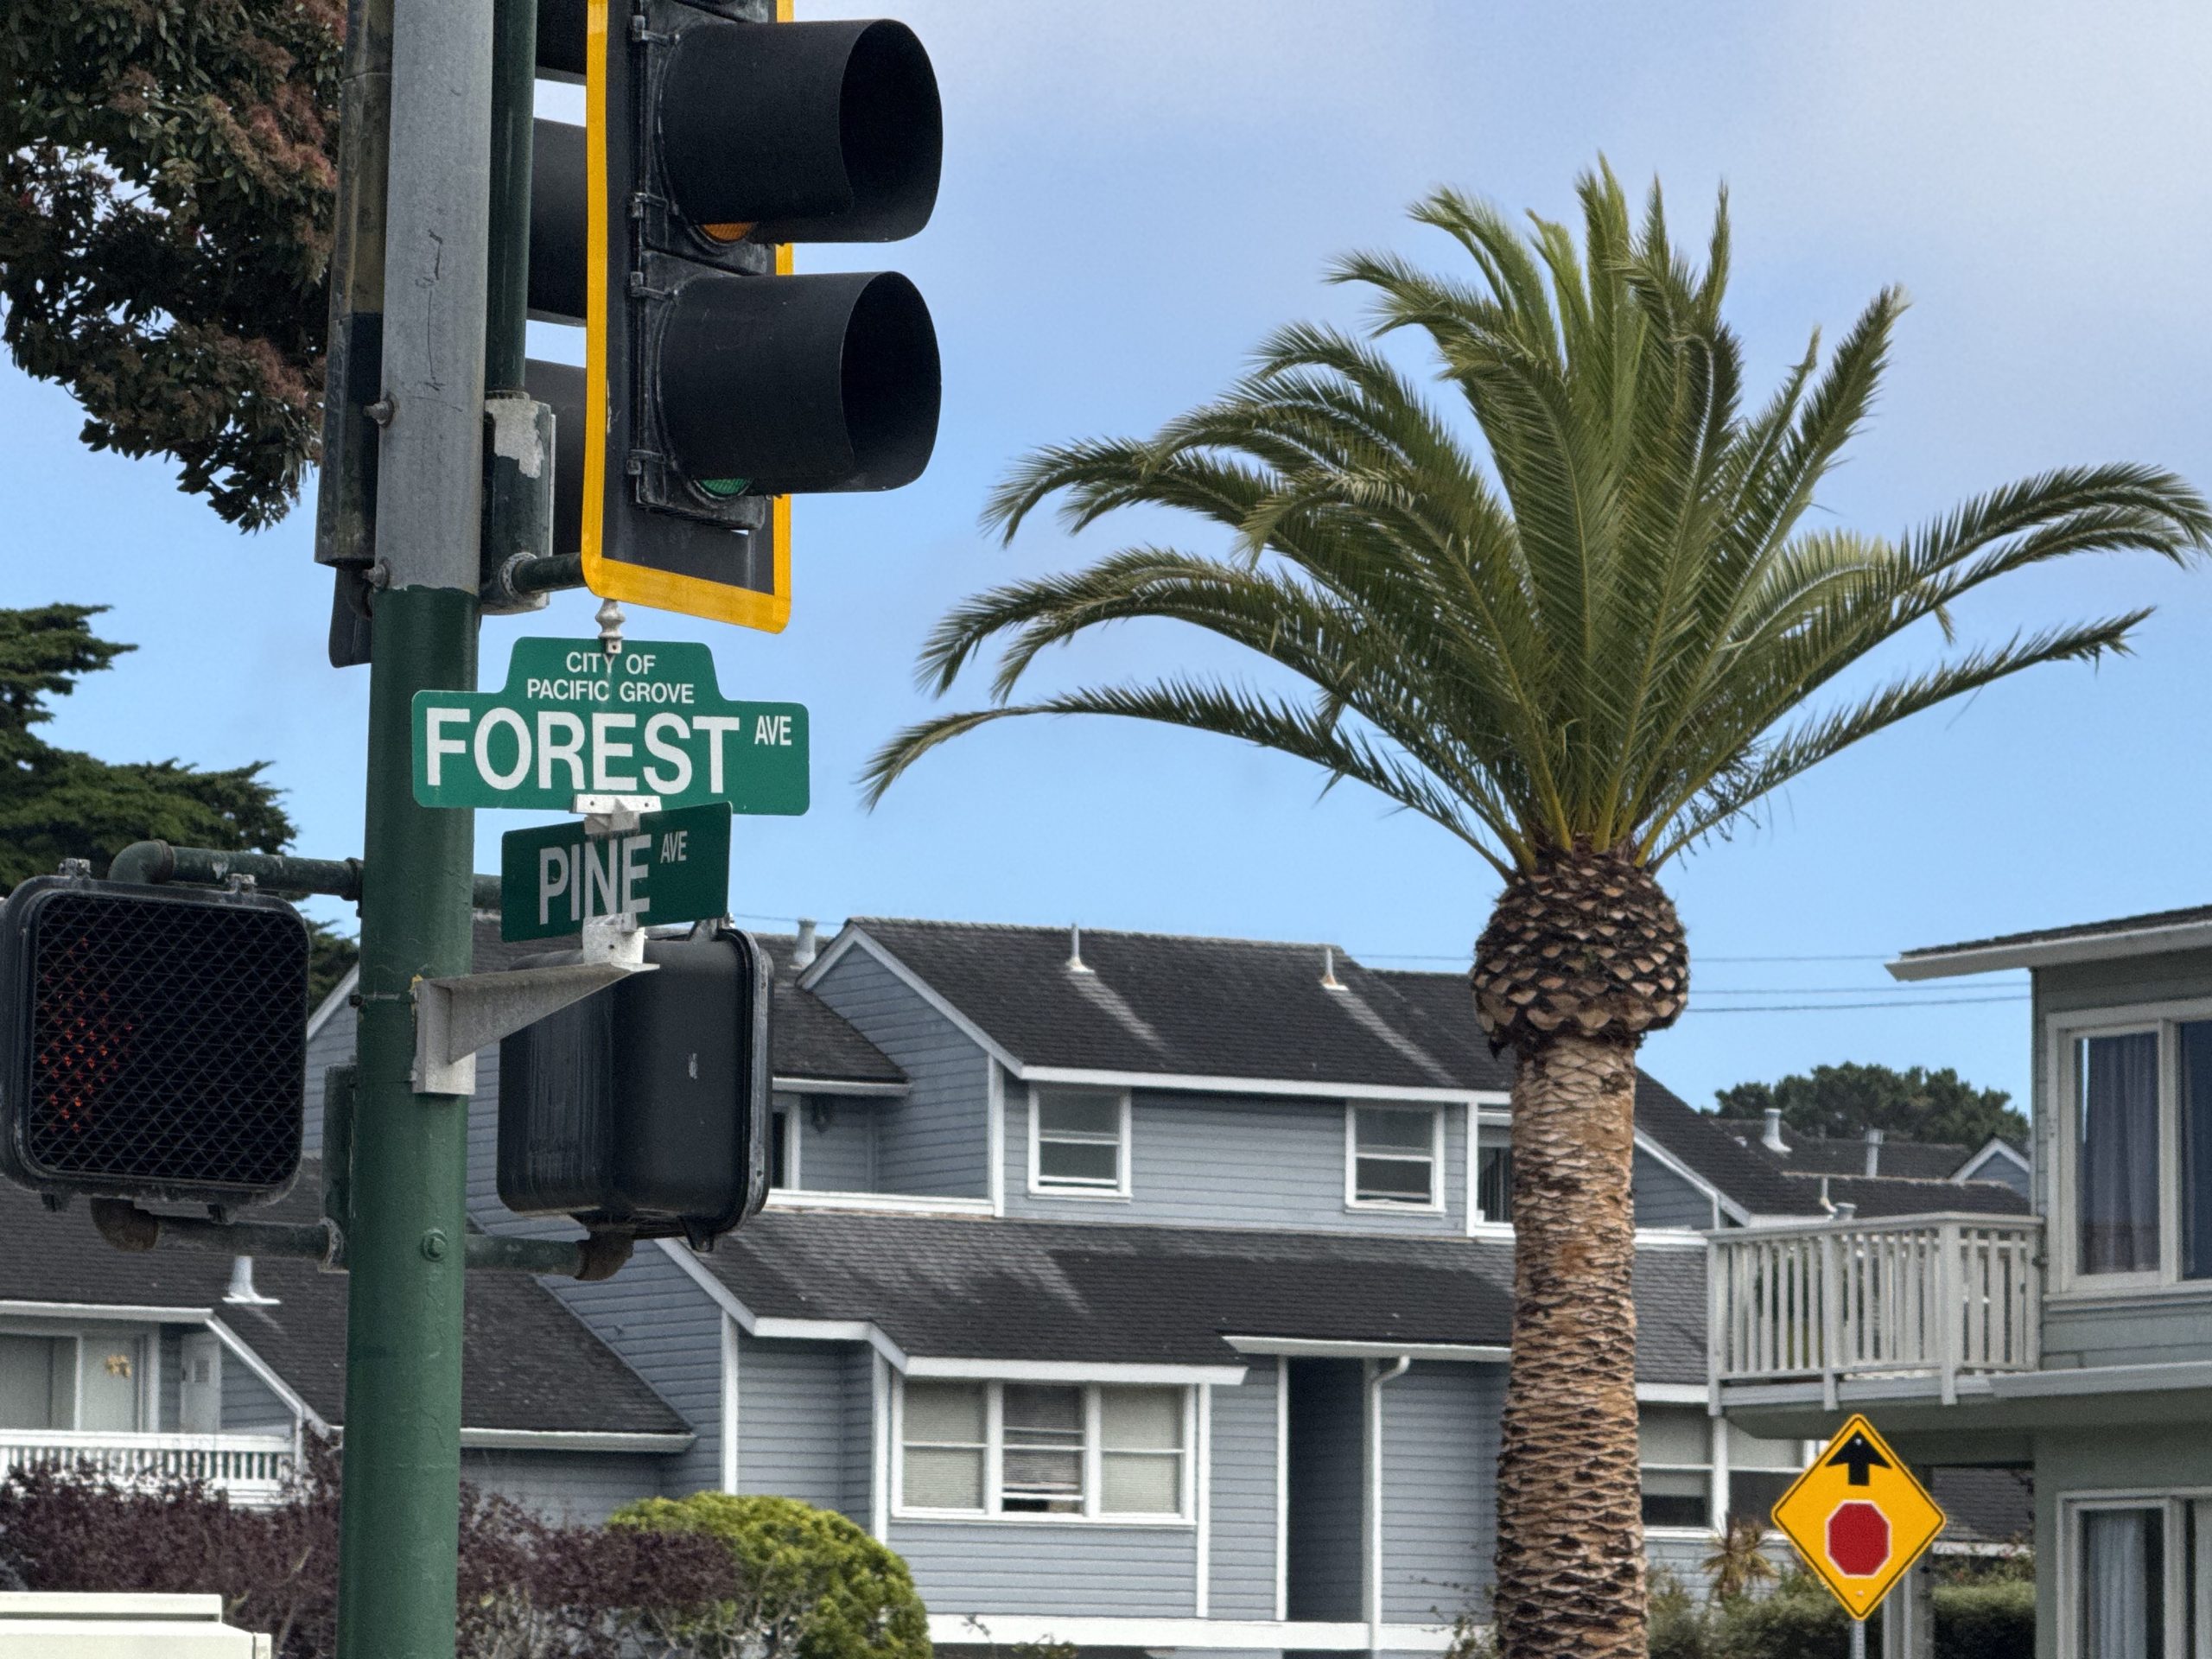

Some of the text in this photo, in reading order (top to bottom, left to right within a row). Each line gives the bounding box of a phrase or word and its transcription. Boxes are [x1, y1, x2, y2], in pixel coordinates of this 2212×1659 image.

[527, 678, 695, 704] PACIFIC GROVE
[566, 652, 657, 675] CITY OF
[427, 707, 792, 794] FOREST AVE
[540, 831, 687, 925] PINE AVE
